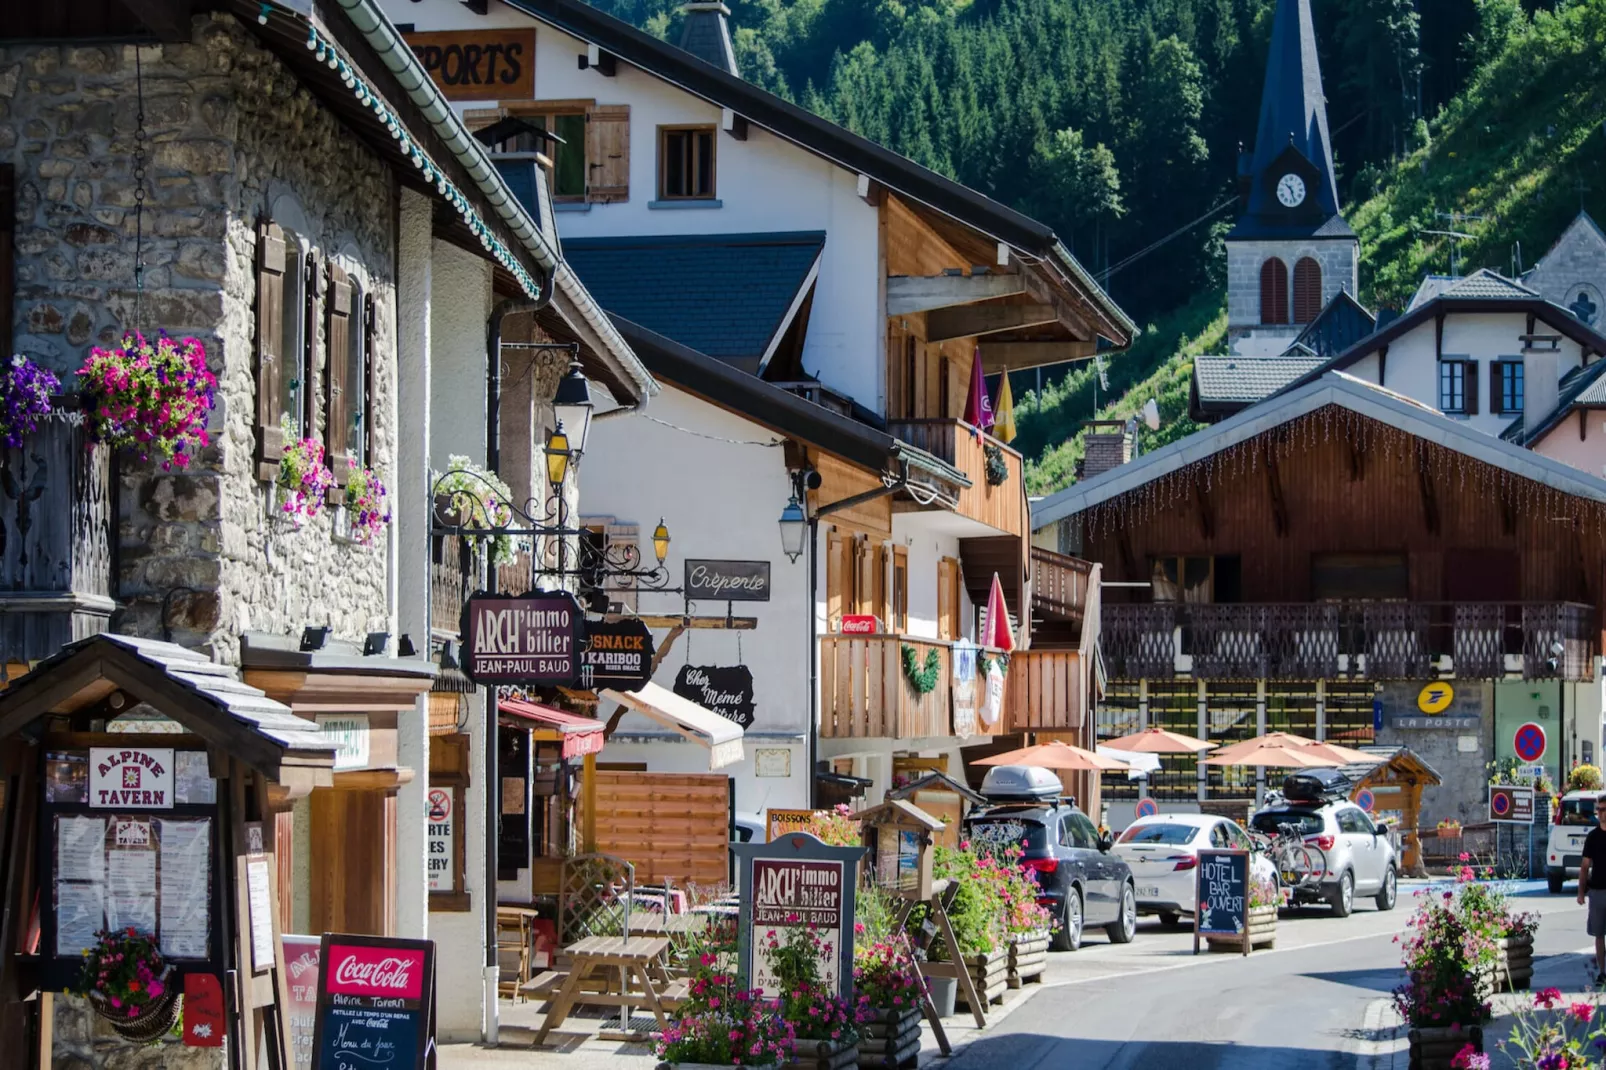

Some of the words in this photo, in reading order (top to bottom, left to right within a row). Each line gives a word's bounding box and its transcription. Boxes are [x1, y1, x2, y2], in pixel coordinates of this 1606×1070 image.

[588, 652, 641, 665] KARIBOO
[474, 660, 536, 674] JEAN-PAUL
[539, 660, 570, 673] BAUD
[686, 669, 711, 691] Chez
[703, 689, 744, 706] Mémé
[1399, 719, 1417, 727] LA
[1425, 719, 1472, 727] POSTE
[98, 751, 165, 778] ALPINE
[98, 789, 165, 805] TAVERN
[771, 813, 811, 824] BOISSONS
[1201, 862, 1241, 883] HOTEL
[1209, 881, 1231, 898] BAR
[1207, 895, 1244, 912] OUVERT
[756, 909, 806, 923] JEAN-PUL
[810, 912, 837, 924] BAUD
[336, 955, 415, 989] Coca-Cola
[360, 1038, 372, 1049] du
